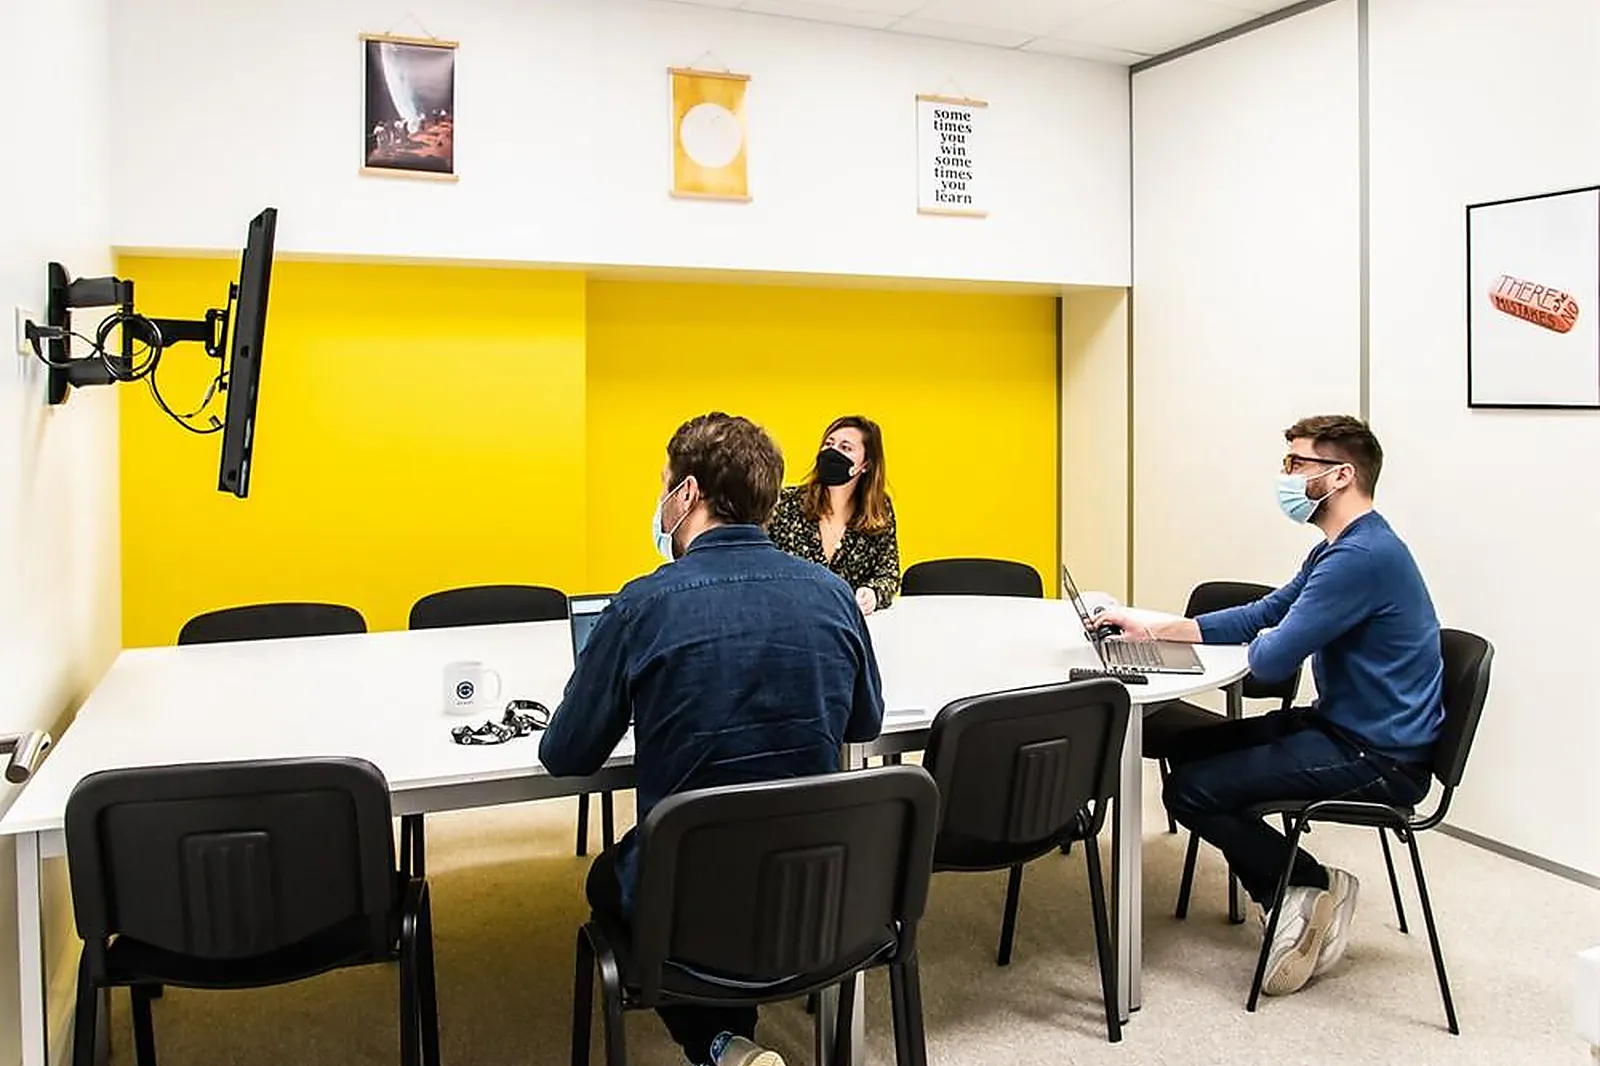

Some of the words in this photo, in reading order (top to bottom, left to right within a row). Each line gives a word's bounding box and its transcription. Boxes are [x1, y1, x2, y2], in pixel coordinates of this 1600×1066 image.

[934, 109, 971, 122] some
[934, 118, 972, 134] times
[940, 132, 965, 145] you
[940, 143, 966, 156] win
[934, 155, 972, 168] some
[934, 165, 972, 180] times
[940, 180, 966, 192] you
[935, 189, 972, 204] learn
[1497, 274, 1559, 311] THERE
[1495, 296, 1556, 326] MISTAKES
[1560, 301, 1579, 327] NO
